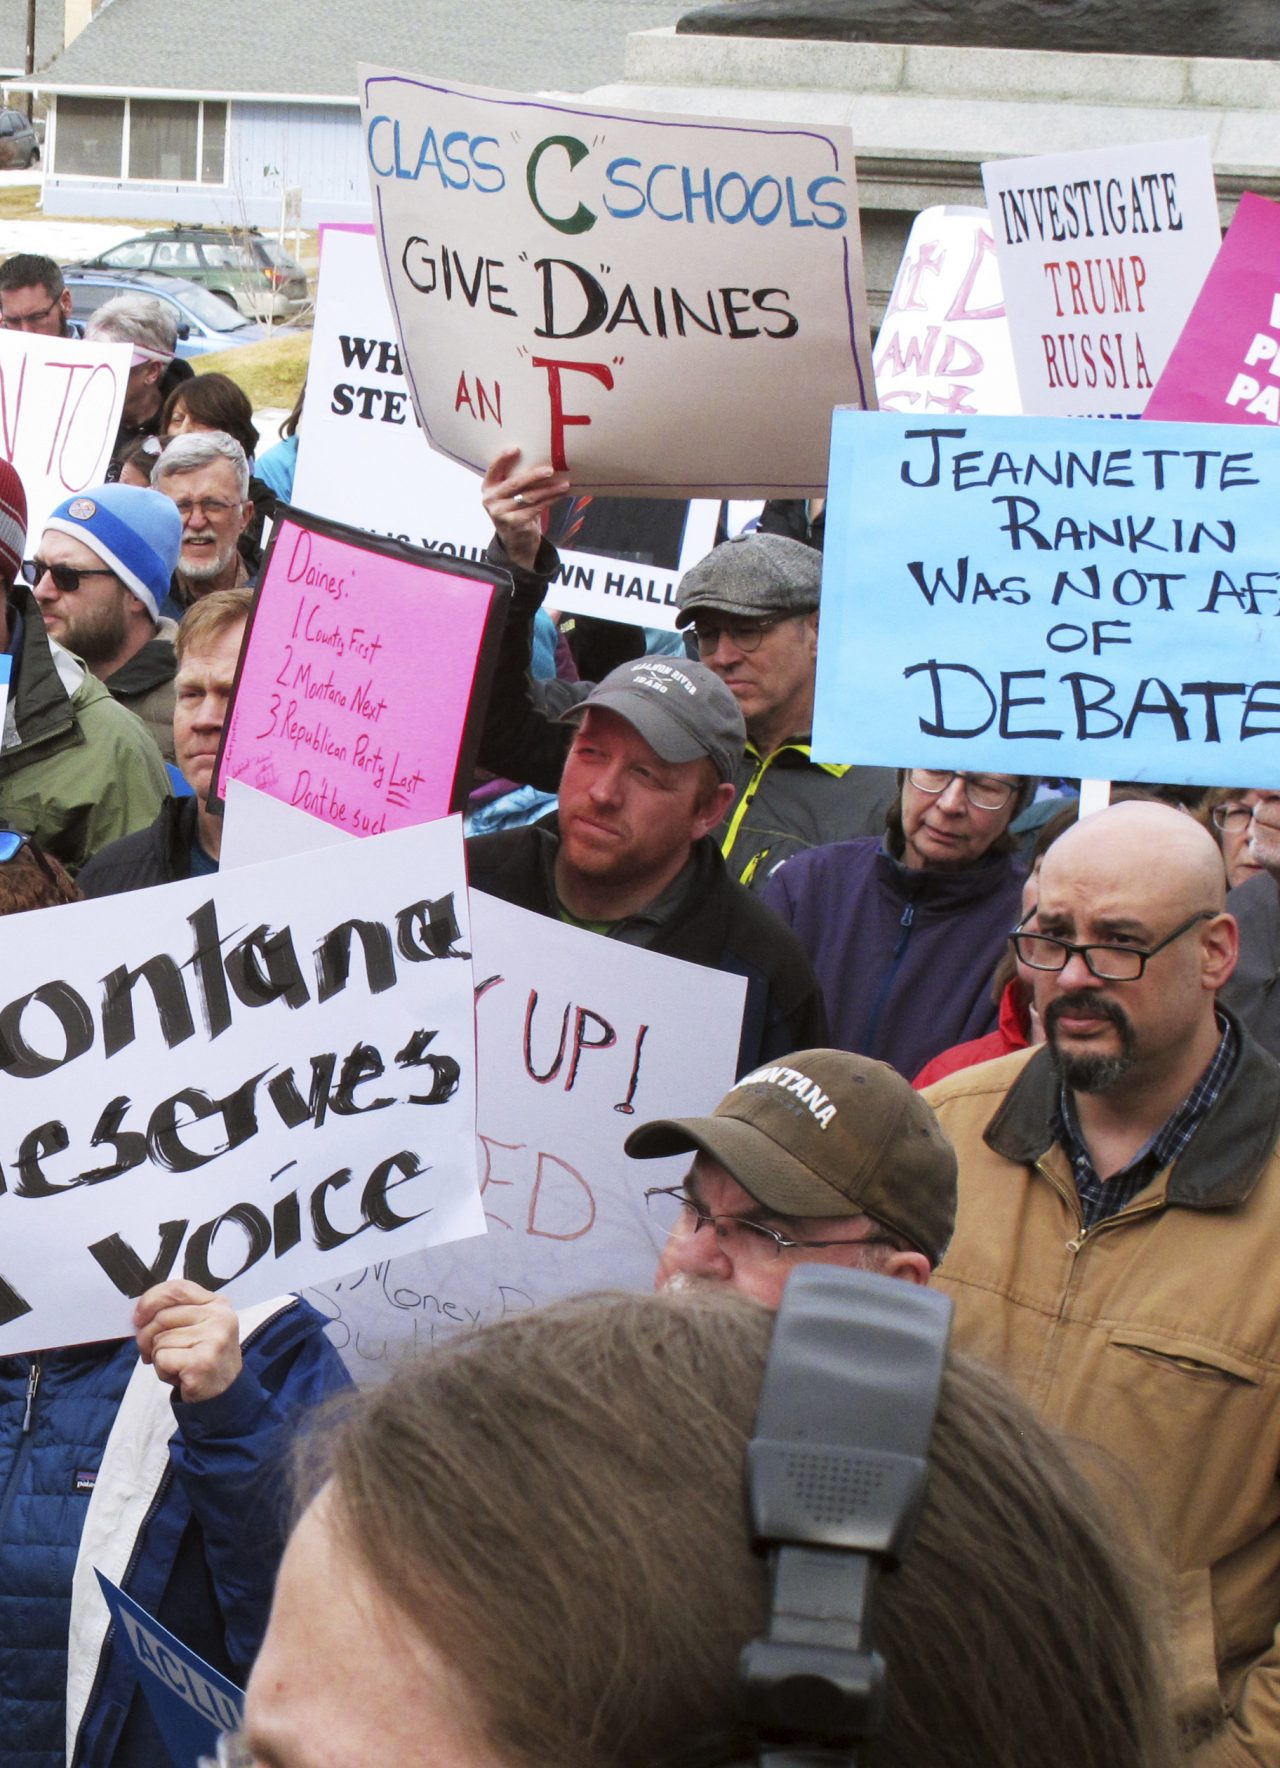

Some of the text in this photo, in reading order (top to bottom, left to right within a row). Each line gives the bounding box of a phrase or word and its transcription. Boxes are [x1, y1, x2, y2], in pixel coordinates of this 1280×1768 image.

[367, 115, 506, 193] CLASS
[603, 156, 848, 230] SCHOOLS
[998, 172, 1183, 245] INVESTIGATE
[402, 236, 518, 317] GIVE
[1043, 255, 1147, 318] TRUMP
[878, 327, 985, 377] AND
[1041, 331, 1154, 389] RUSSIA
[45, 362, 117, 492] TO
[331, 383, 421, 429] STE
[454, 371, 503, 428] AN
[900, 428, 1260, 491] JEANNETTE
[992, 496, 1236, 553] RANKIN
[604, 571, 677, 607] HALL
[907, 556, 1280, 617] WAS NOT AF
[305, 604, 345, 657] Country
[349, 627, 383, 666] First
[1046, 620, 1133, 656] OF
[292, 663, 347, 708] Montana
[349, 679, 388, 723] Next
[670, 669, 697, 696] RIVER
[903, 658, 1280, 743] DEBATE
[280, 700, 347, 764] Republican
[351, 733, 385, 789] Party
[388, 751, 426, 795] Last
[329, 788, 346, 822] be
[87, 1149, 434, 1300] voice
[135, 1625, 240, 1731] ACLU
